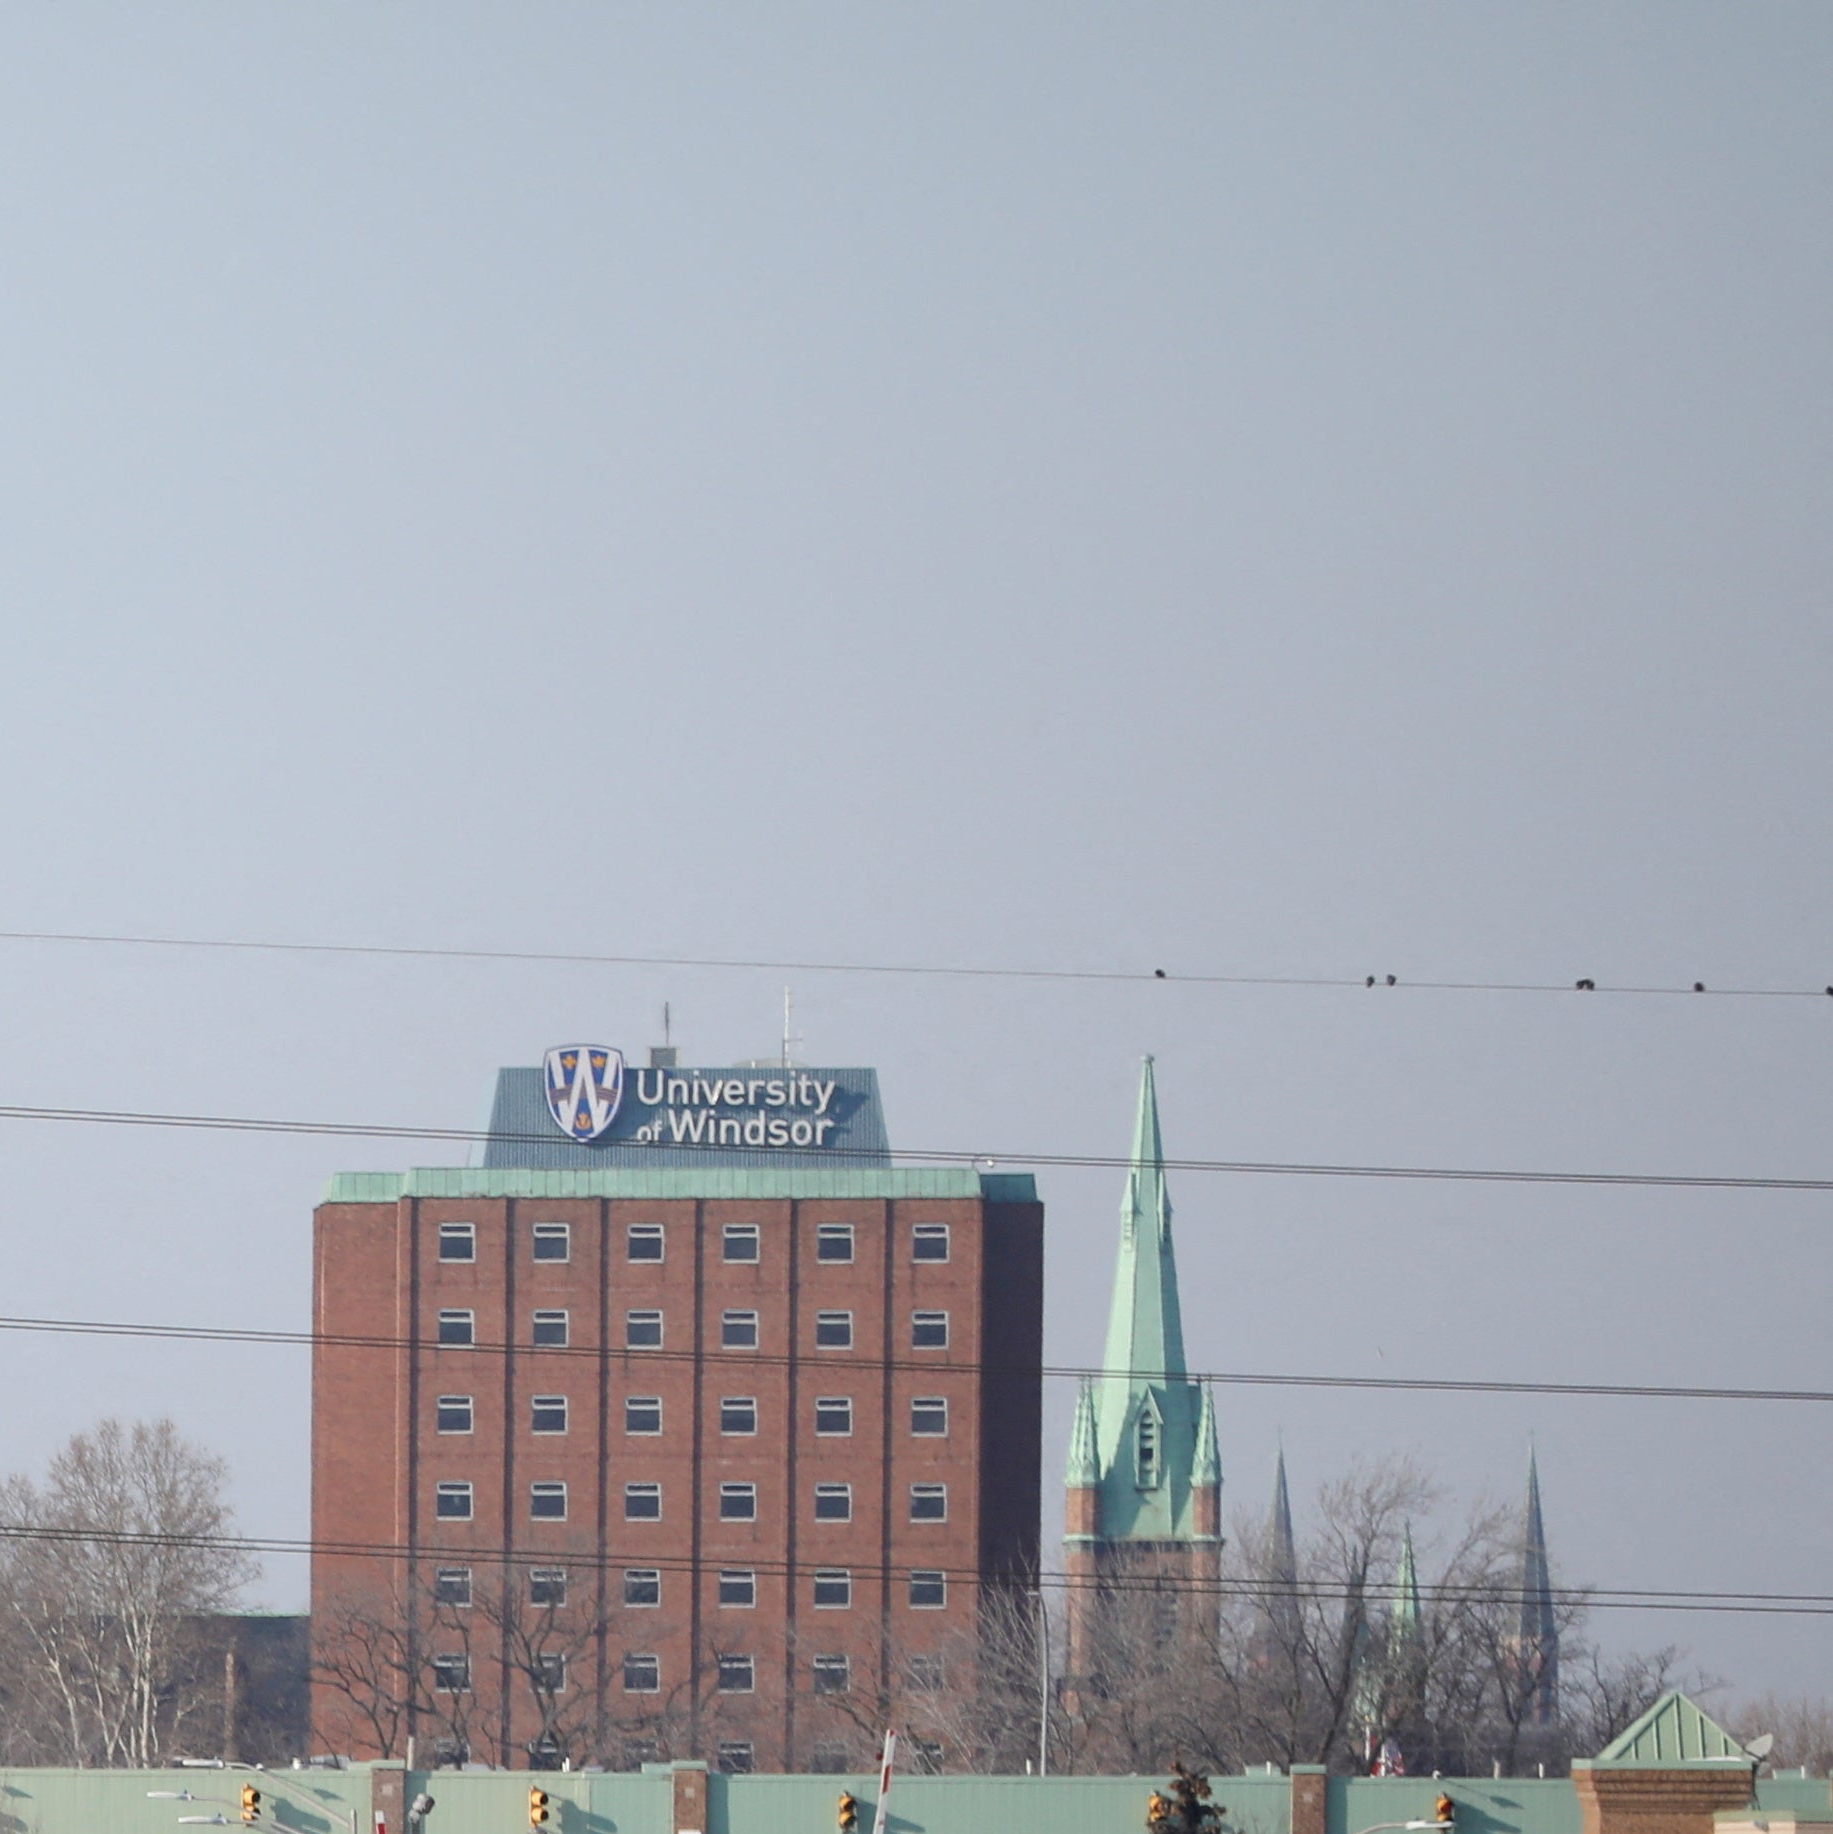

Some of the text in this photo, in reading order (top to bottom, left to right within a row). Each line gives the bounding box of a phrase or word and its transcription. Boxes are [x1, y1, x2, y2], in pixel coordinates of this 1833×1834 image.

[636, 1070, 835, 1114] University
[636, 1109, 834, 1146] of Windsor
